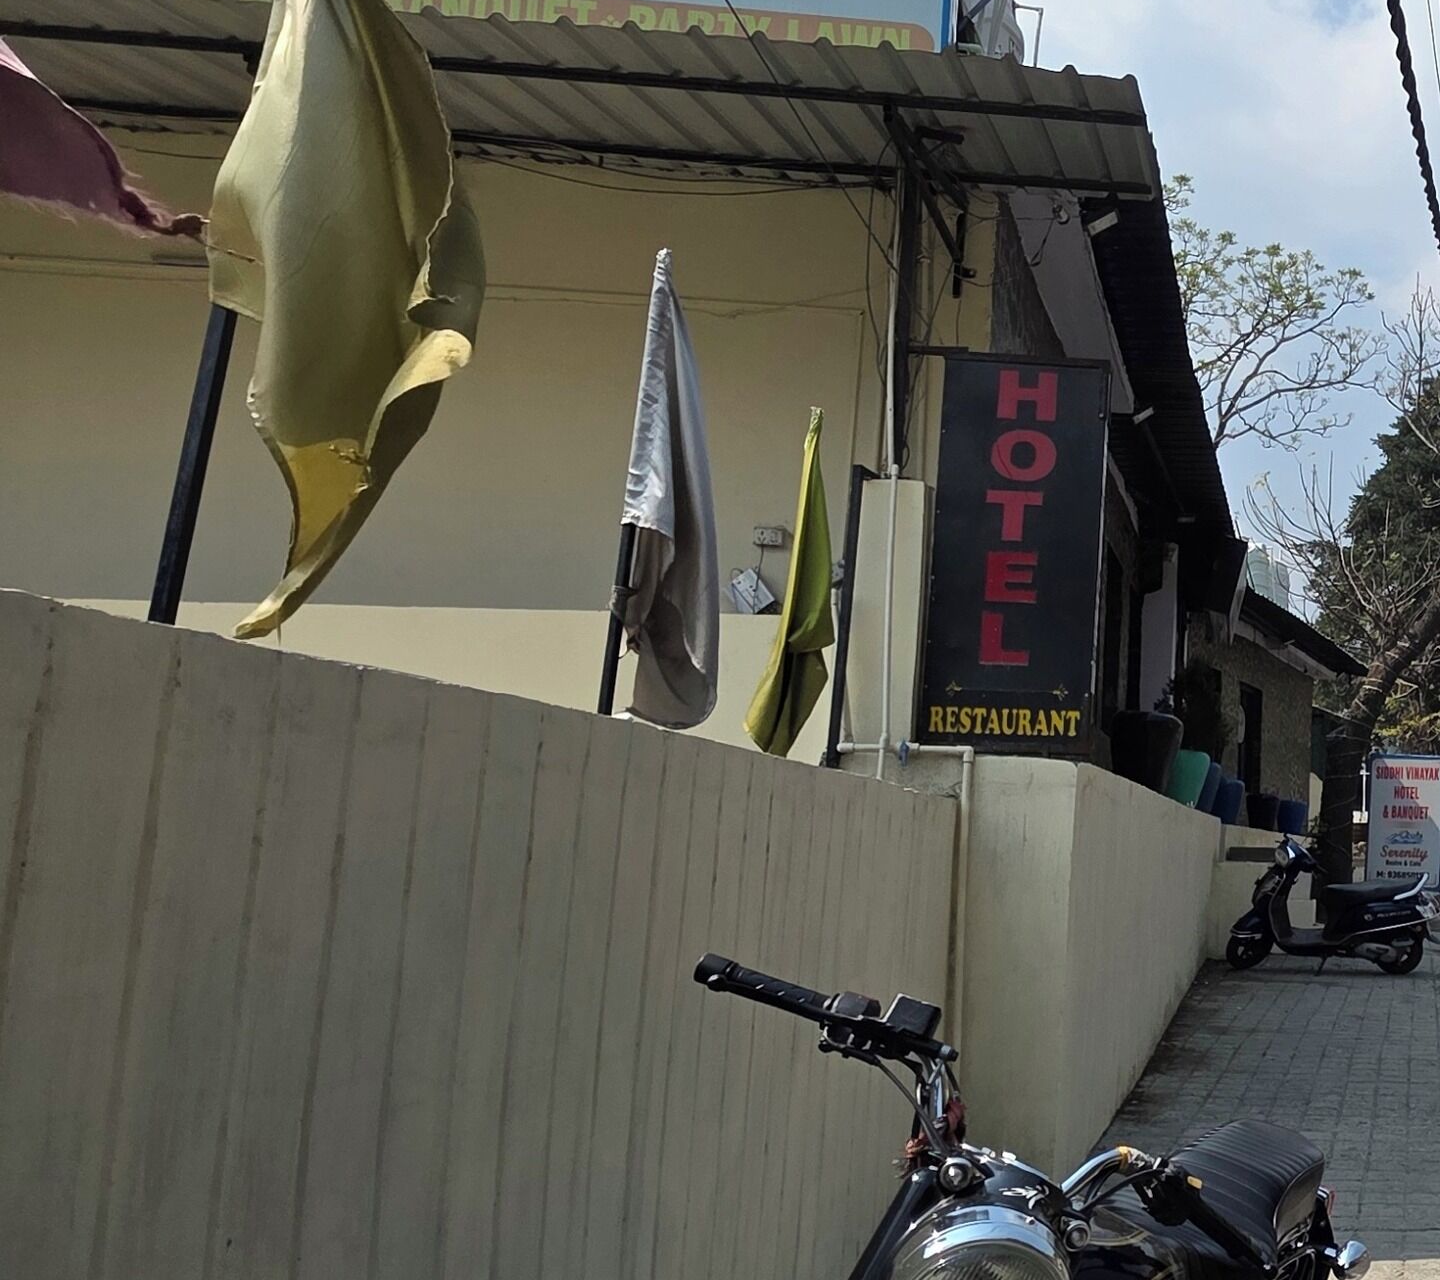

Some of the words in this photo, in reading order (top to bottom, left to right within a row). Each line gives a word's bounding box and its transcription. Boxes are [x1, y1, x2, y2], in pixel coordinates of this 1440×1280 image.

[978, 368, 1059, 667] HOTEL
[928, 705, 1081, 737] RESTAURANT
[1376, 766, 1404, 780] SIDDHI
[1406, 766, 1440, 781] VINAYAK
[1394, 785, 1419, 800] HOTEL
[1383, 805, 1390, 819] &
[1392, 805, 1429, 820] BANQUET
[1380, 844, 1428, 862] Serenity
